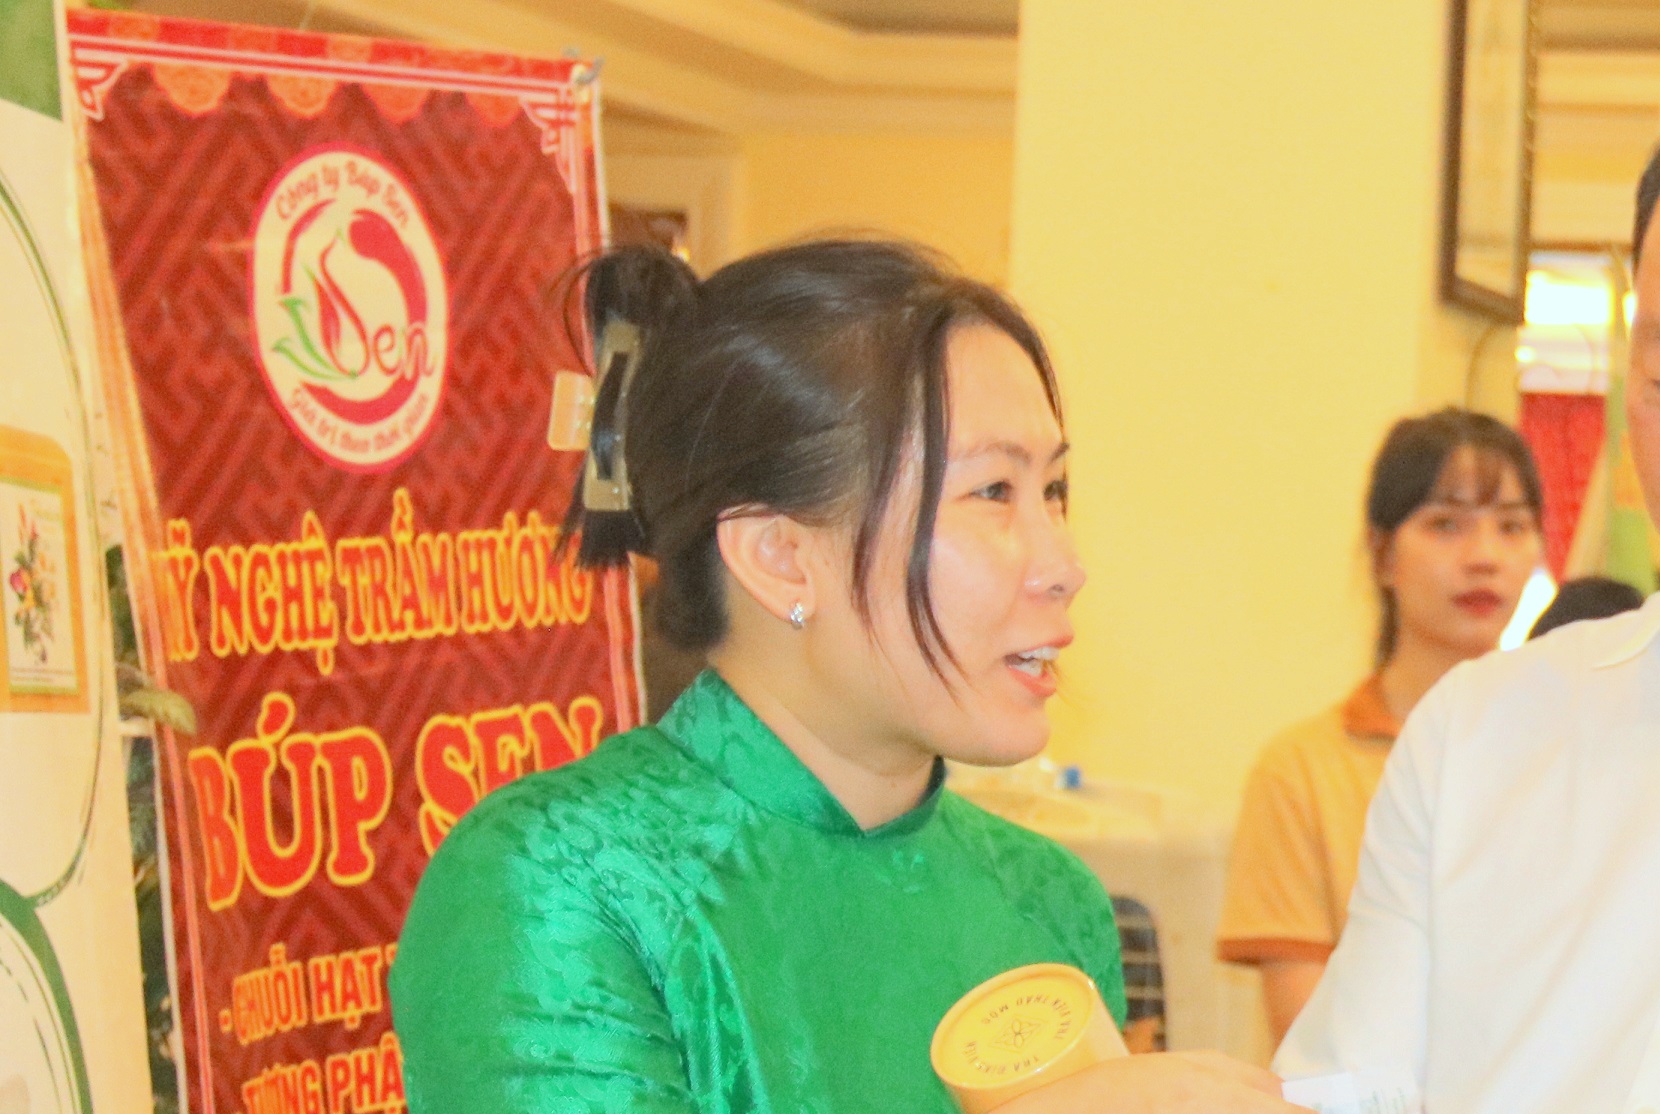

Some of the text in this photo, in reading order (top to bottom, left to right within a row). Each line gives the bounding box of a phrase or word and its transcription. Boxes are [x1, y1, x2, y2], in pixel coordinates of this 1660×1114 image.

[203, 510, 340, 676] NGHỆ
[335, 487, 459, 644] TRẦM
[187, 692, 394, 912] BÚP
[308, 945, 383, 1030] HẠT
